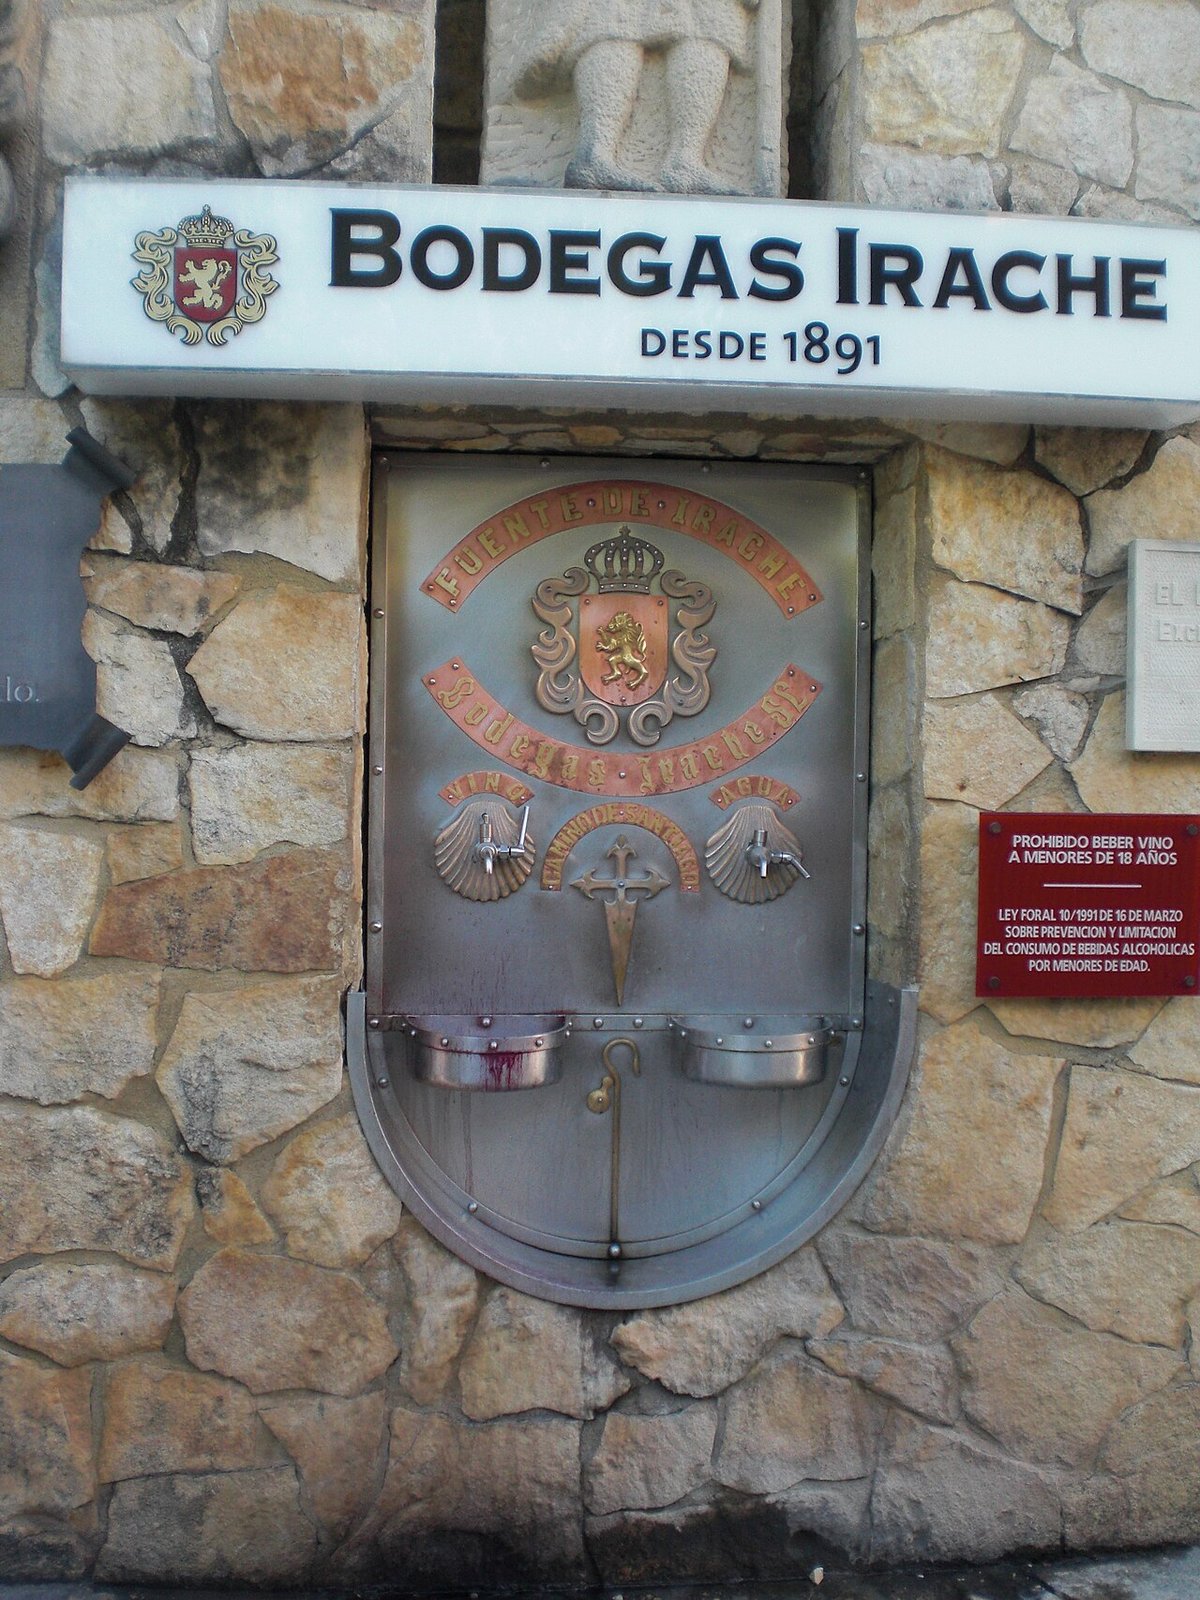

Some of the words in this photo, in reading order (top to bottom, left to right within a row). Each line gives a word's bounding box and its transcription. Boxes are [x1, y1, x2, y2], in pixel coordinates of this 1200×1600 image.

[328, 207, 806, 302] BODEGAS
[835, 226, 1168, 324] IRACHE
[641, 328, 767, 361] DESDE
[783, 321, 881, 374] 1891
[434, 492, 583, 598] FUENTE
[602, 487, 651, 516] DE
[671, 495, 806, 601] IRACHE
[438, 676, 607, 787] Bodegas
[637, 720, 766, 794] Irache
[447, 772, 525, 802] VINO
[720, 777, 790, 806] AGUA
[541, 812, 592, 885] CAMINO
[592, 804, 619, 828] DE
[627, 804, 700, 885] SANTIAGO
[1013, 835, 1089, 849] PROHIBIDO
[1092, 836, 1134, 849] BEBER
[1138, 836, 1174, 850] VINO
[1008, 851, 1021, 864] A
[1024, 851, 1092, 864] MENORES
[1096, 852, 1114, 864] DE
[1117, 852, 1132, 864] 18
[1136, 849, 1177, 866] AÑOS
[998, 909, 1018, 921] LEY
[1021, 909, 1057, 921] FORAL
[1059, 909, 1098, 922] 10/1991
[1099, 910, 1113, 922] DE
[1115, 910, 1126, 922] 16
[1128, 910, 1142, 922] DE
[1144, 910, 1183, 922] MARZO
[1005, 926, 1039, 938] SOBRE
[1041, 926, 1106, 938] PREVENCION
[1108, 927, 1117, 938] Y
[1119, 927, 1176, 939] LIMITACION
[984, 943, 1003, 955] DEL
[1006, 943, 1060, 955] CONSUMO
[1062, 943, 1076, 955] DE
[1078, 943, 1119, 955] BEBIDAS
[1121, 943, 1195, 956] ALCOHOLICAS
[1028, 960, 1050, 972] POR
[1052, 960, 1102, 972] MENORES
[1105, 960, 1118, 972] DE
[1120, 960, 1151, 972] EDAD.
